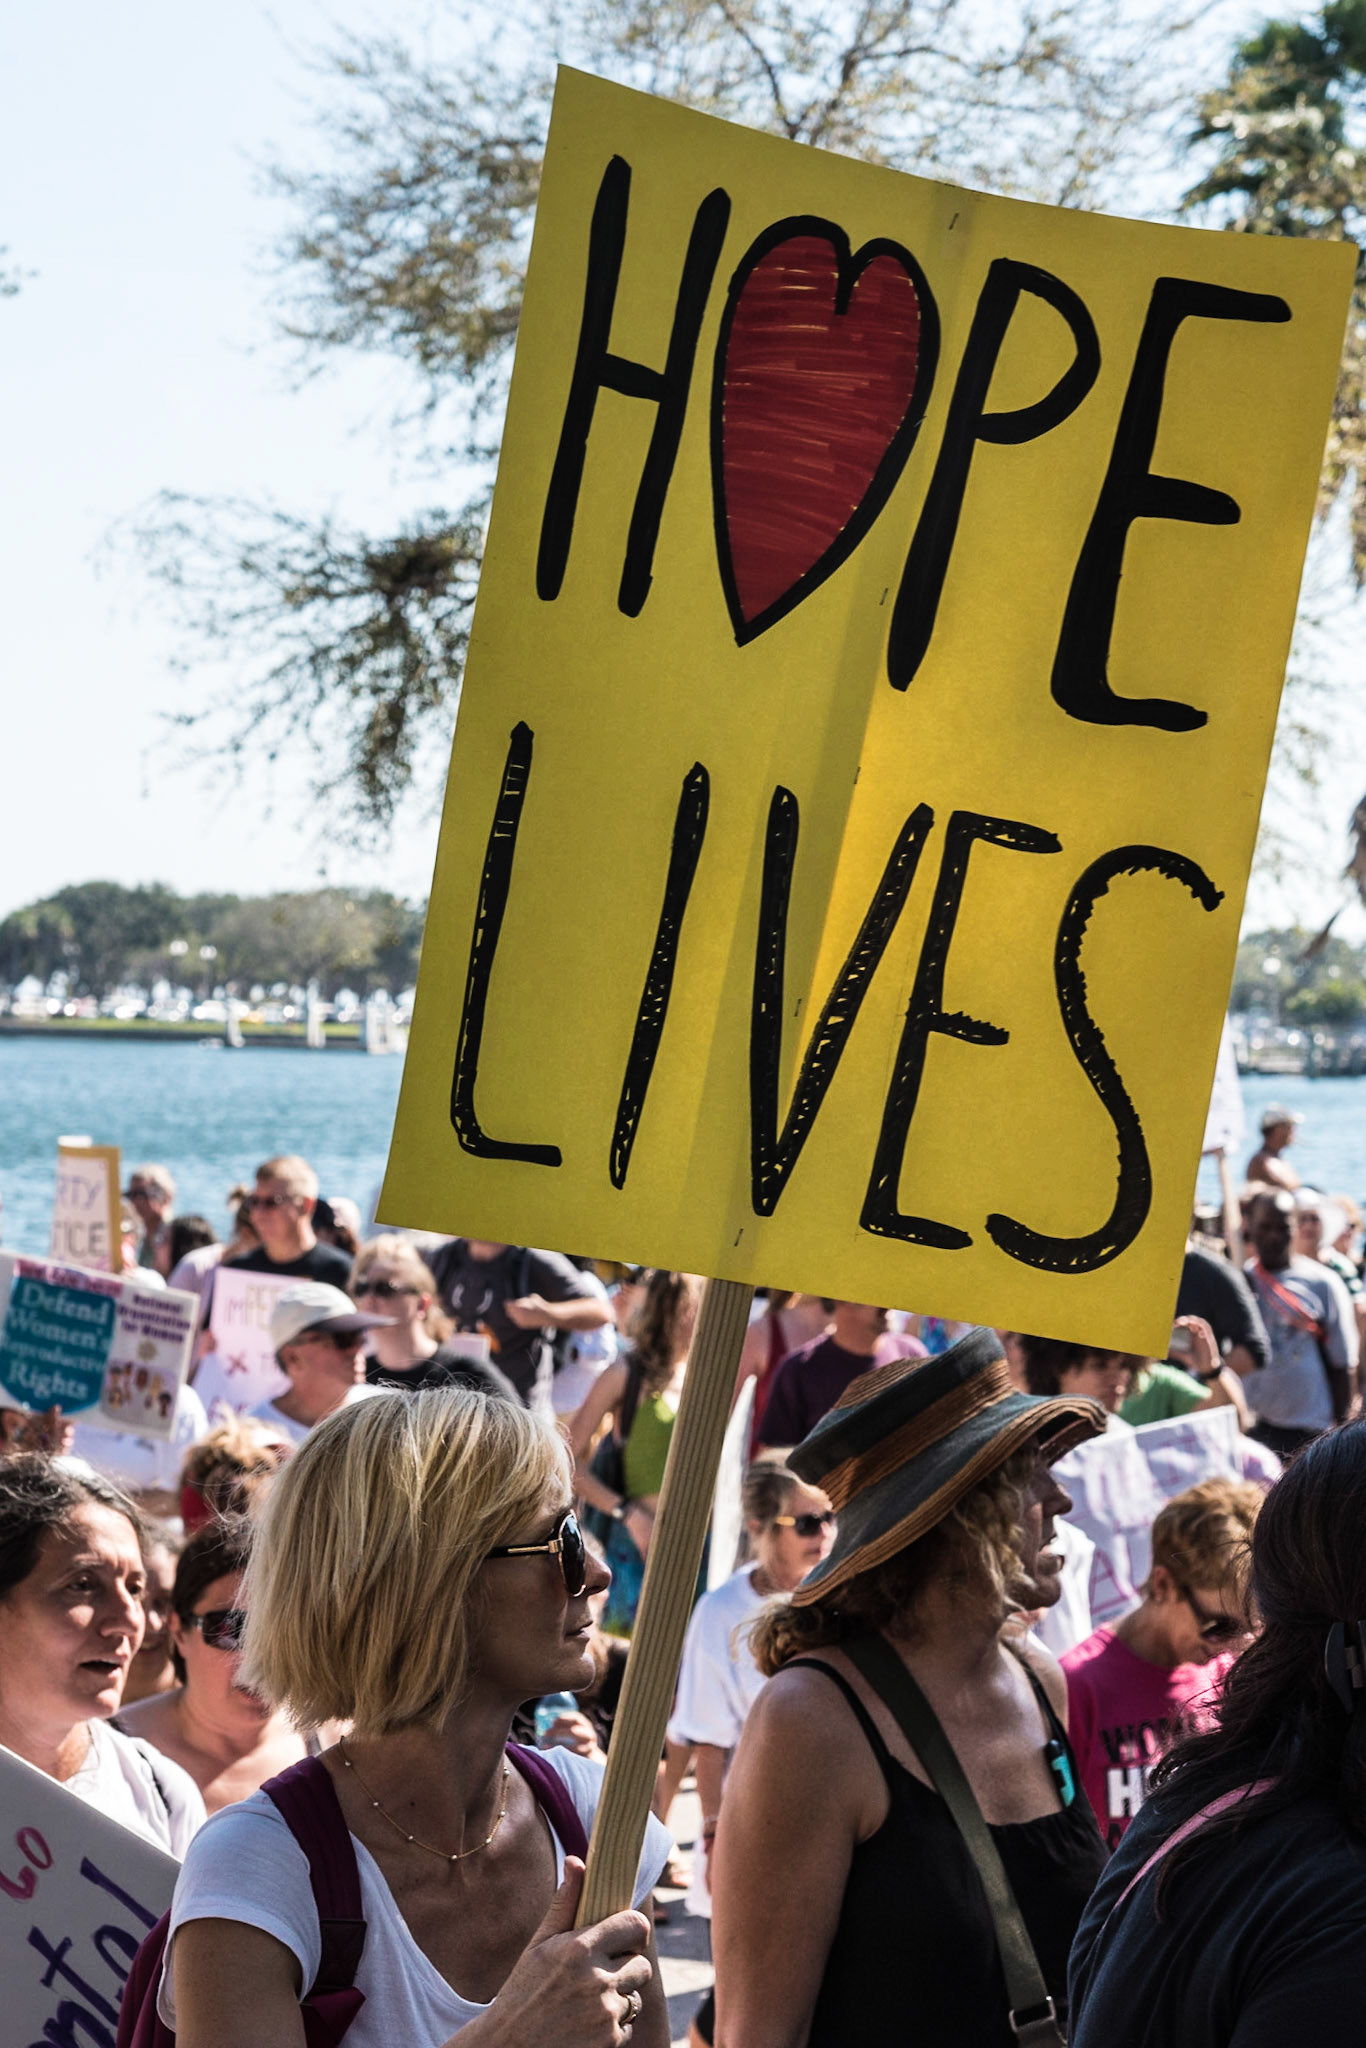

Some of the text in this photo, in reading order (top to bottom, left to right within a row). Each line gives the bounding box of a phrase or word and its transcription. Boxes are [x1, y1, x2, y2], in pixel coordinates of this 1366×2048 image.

[536, 154, 1292, 732] HOPE
[450, 721, 1224, 1274] LIVES
[22, 1283, 110, 1325] Defend
[8, 1305, 113, 1351] Women's
[9, 1359, 88, 1399] Rights
